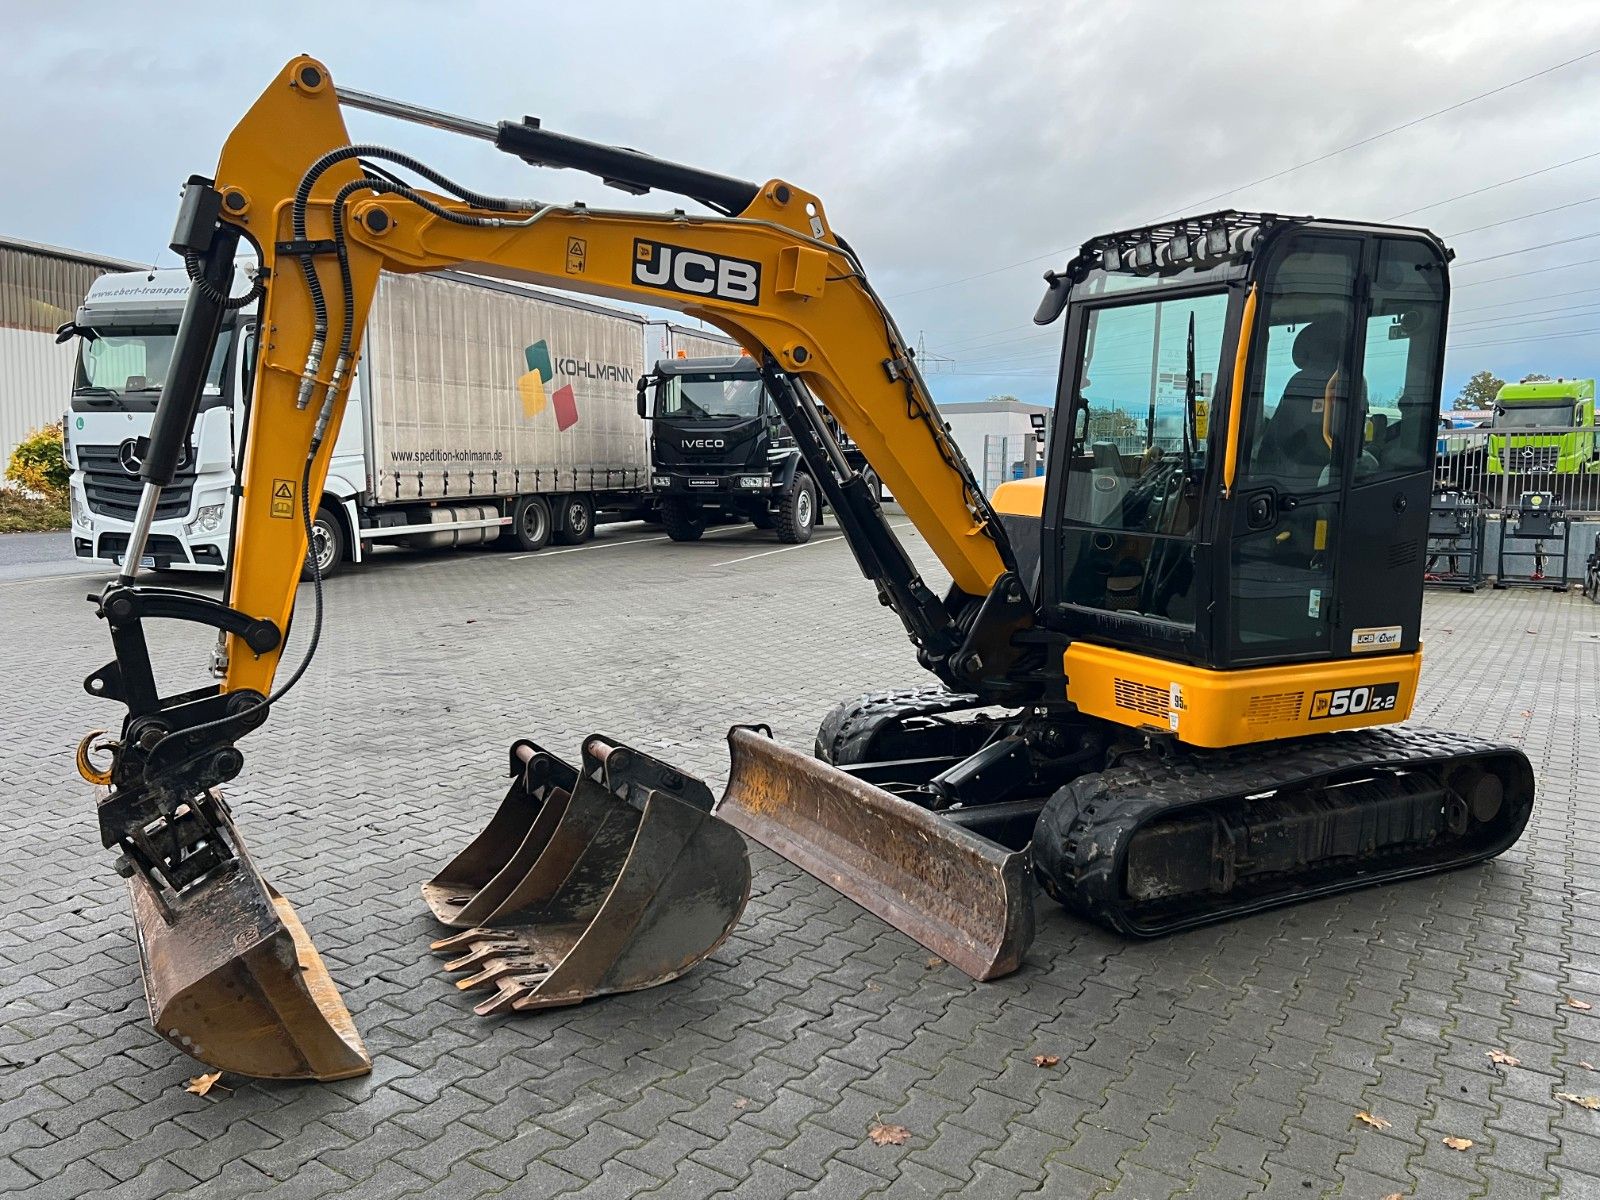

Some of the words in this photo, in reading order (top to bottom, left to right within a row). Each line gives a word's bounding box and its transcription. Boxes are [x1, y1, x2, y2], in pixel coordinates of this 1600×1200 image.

[636, 247, 757, 301] JCB
[555, 357, 634, 383] KOHLMANN
[681, 439, 724, 448] IVECO
[391, 450, 503, 462] www.spedition-kohlmann.de
[1358, 634, 1375, 643] JCB
[1174, 694, 1184, 709] 95
[1329, 687, 1369, 715] 50
